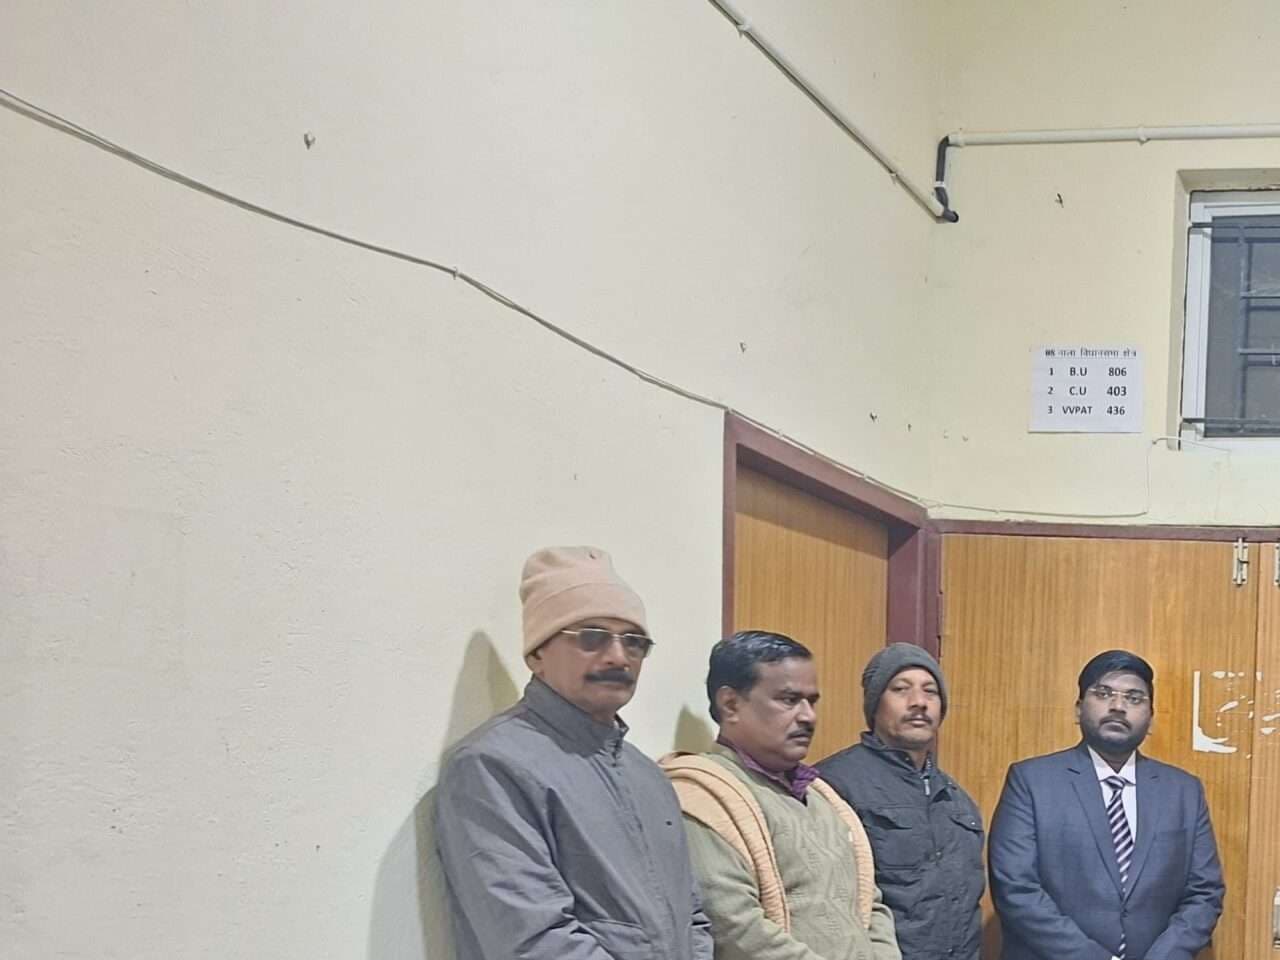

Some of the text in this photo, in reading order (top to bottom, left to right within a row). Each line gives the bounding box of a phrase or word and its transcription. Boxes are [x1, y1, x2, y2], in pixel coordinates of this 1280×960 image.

[1049, 367, 1127, 377] 1 B.U 806
[1048, 386, 1127, 396] 2 C.U 403
[1048, 406, 1125, 415] 3 VVPAT 436
